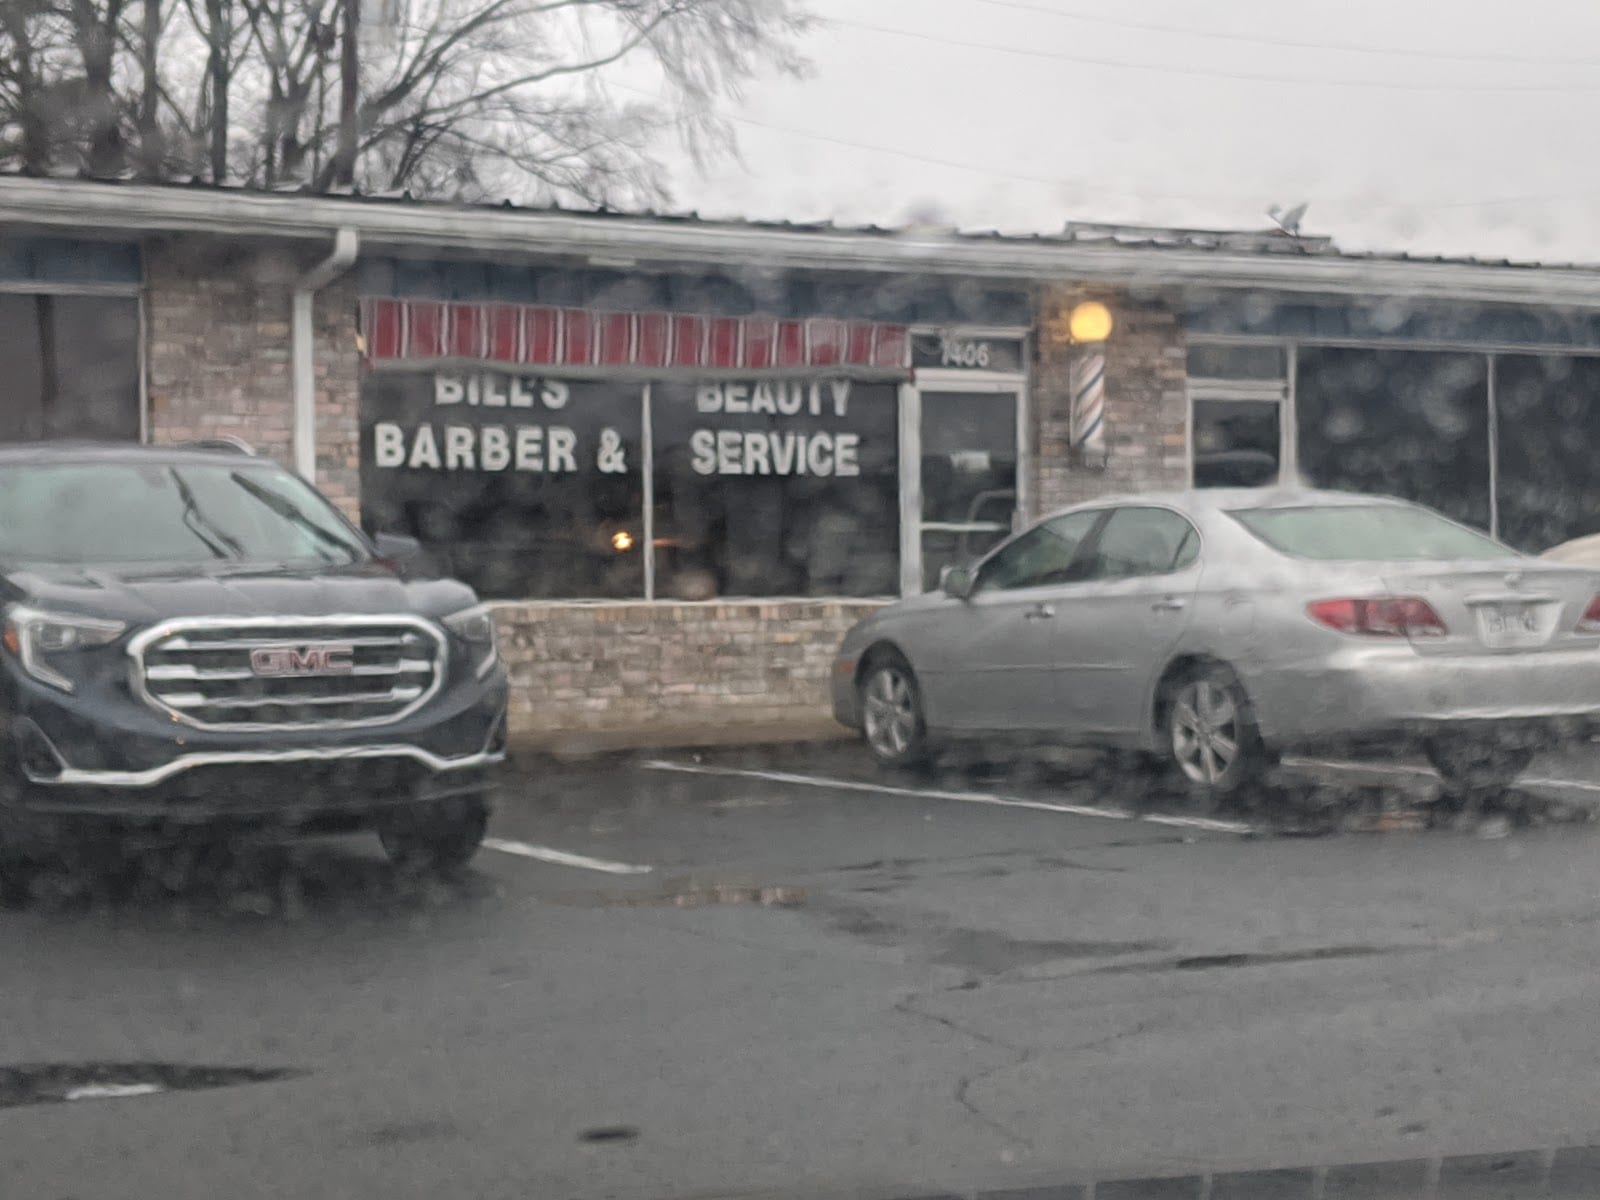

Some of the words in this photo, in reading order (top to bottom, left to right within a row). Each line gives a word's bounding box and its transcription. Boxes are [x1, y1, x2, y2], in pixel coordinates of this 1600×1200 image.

[696, 381, 850, 416] BEAUTY
[375, 422, 577, 472] BARBER
[598, 428, 628, 474] &
[691, 429, 860, 477] SERVICE
[250, 646, 353, 676] GMC
